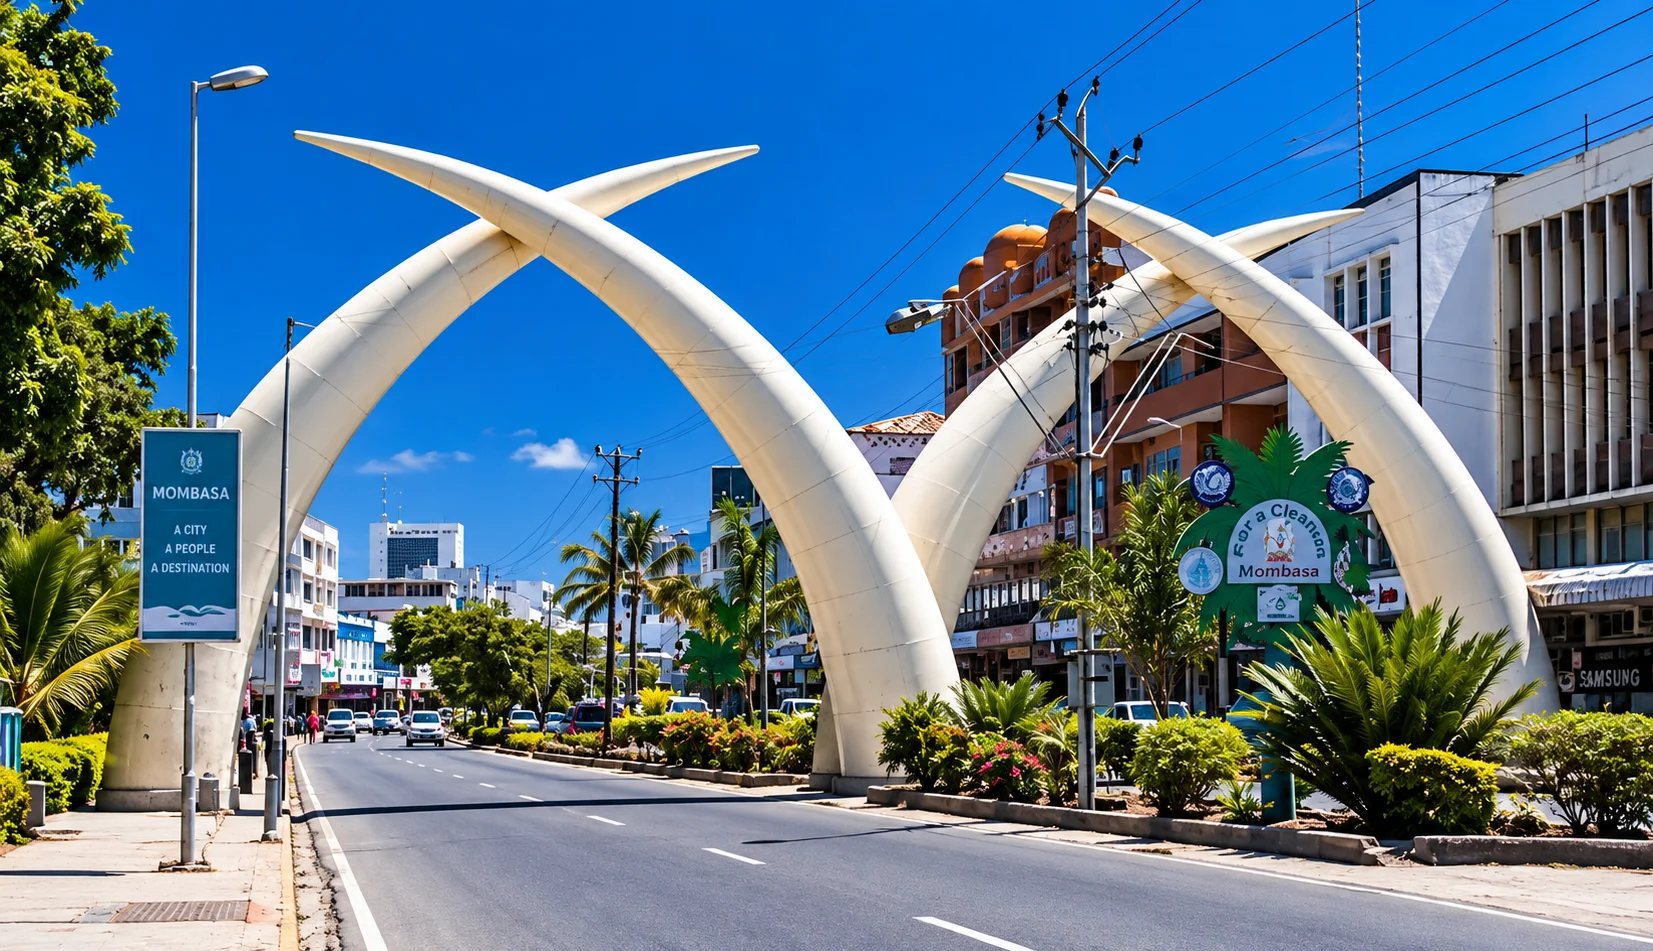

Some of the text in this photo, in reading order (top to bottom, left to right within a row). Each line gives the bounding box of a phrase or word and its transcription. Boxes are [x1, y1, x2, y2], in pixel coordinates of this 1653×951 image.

[152, 486, 230, 500] MOMBASA
[174, 524, 208, 535] A CITY
[1233, 520, 1253, 558] For
[1255, 510, 1267, 523] a
[164, 543, 216, 554] A PEOPLE
[150, 562, 230, 574] A DESTINATION
[1238, 563, 1319, 578] Mombasa
[1579, 668, 1640, 688] SAMSUNG
